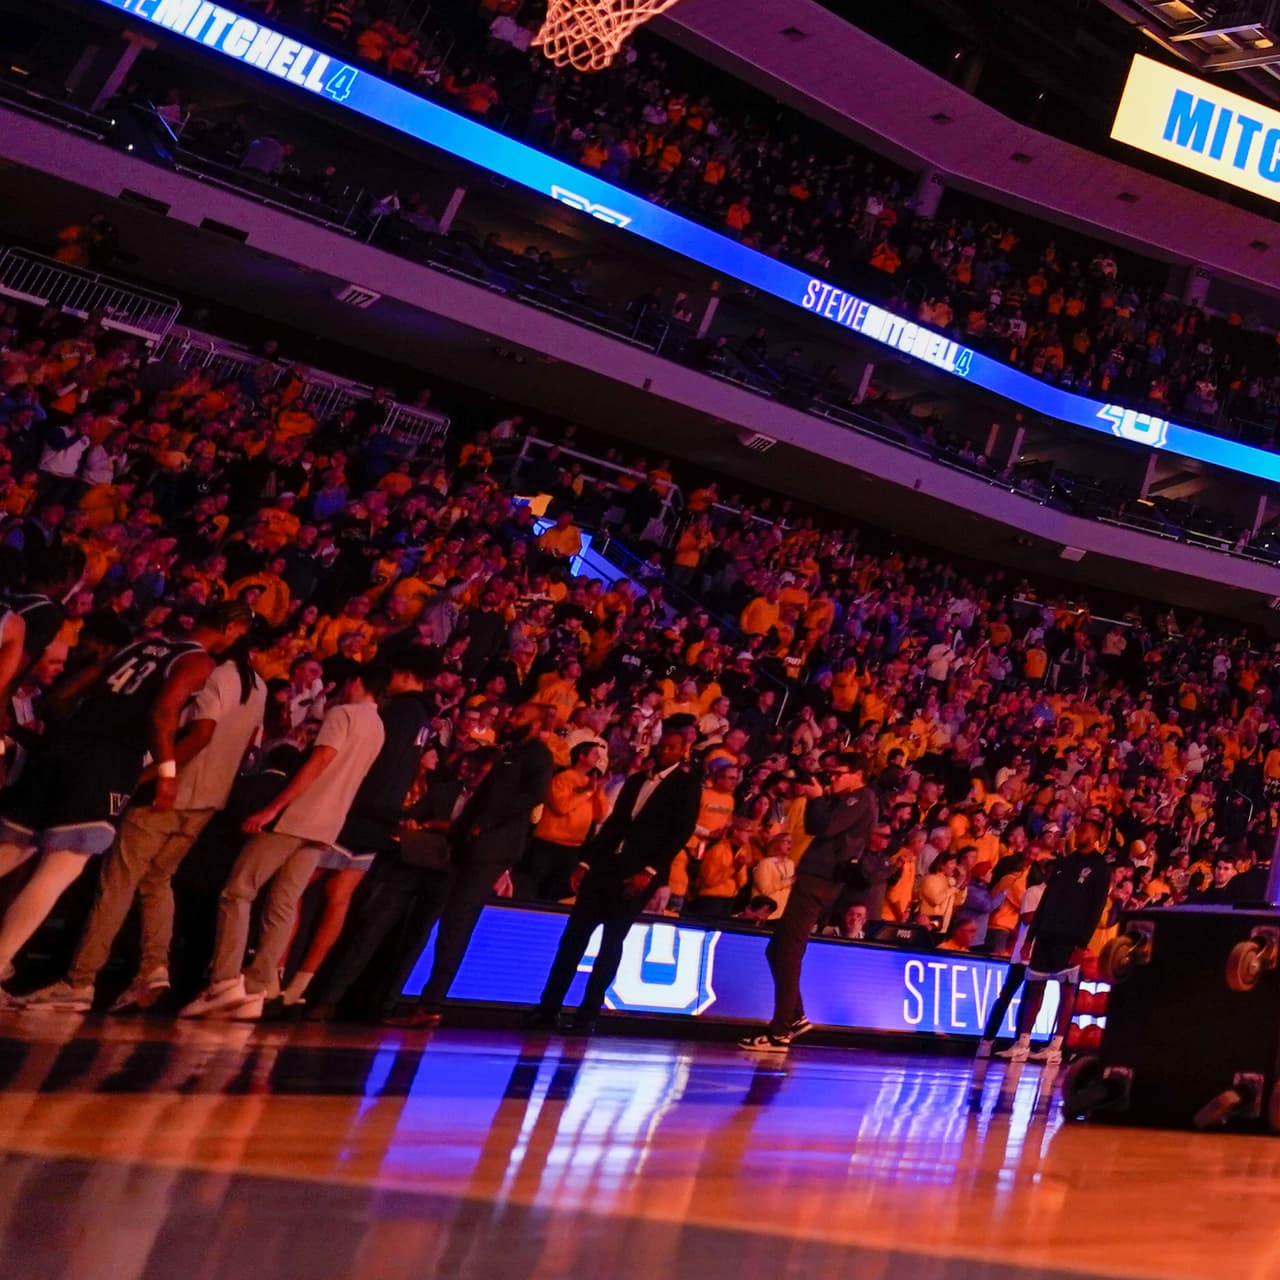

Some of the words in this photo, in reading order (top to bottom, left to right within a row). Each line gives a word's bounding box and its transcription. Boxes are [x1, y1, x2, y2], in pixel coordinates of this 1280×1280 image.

[326, 65, 359, 102] 4
[801, 278, 869, 333] STEVIE
[954, 349, 973, 378] 4
[107, 656, 158, 697] 43
